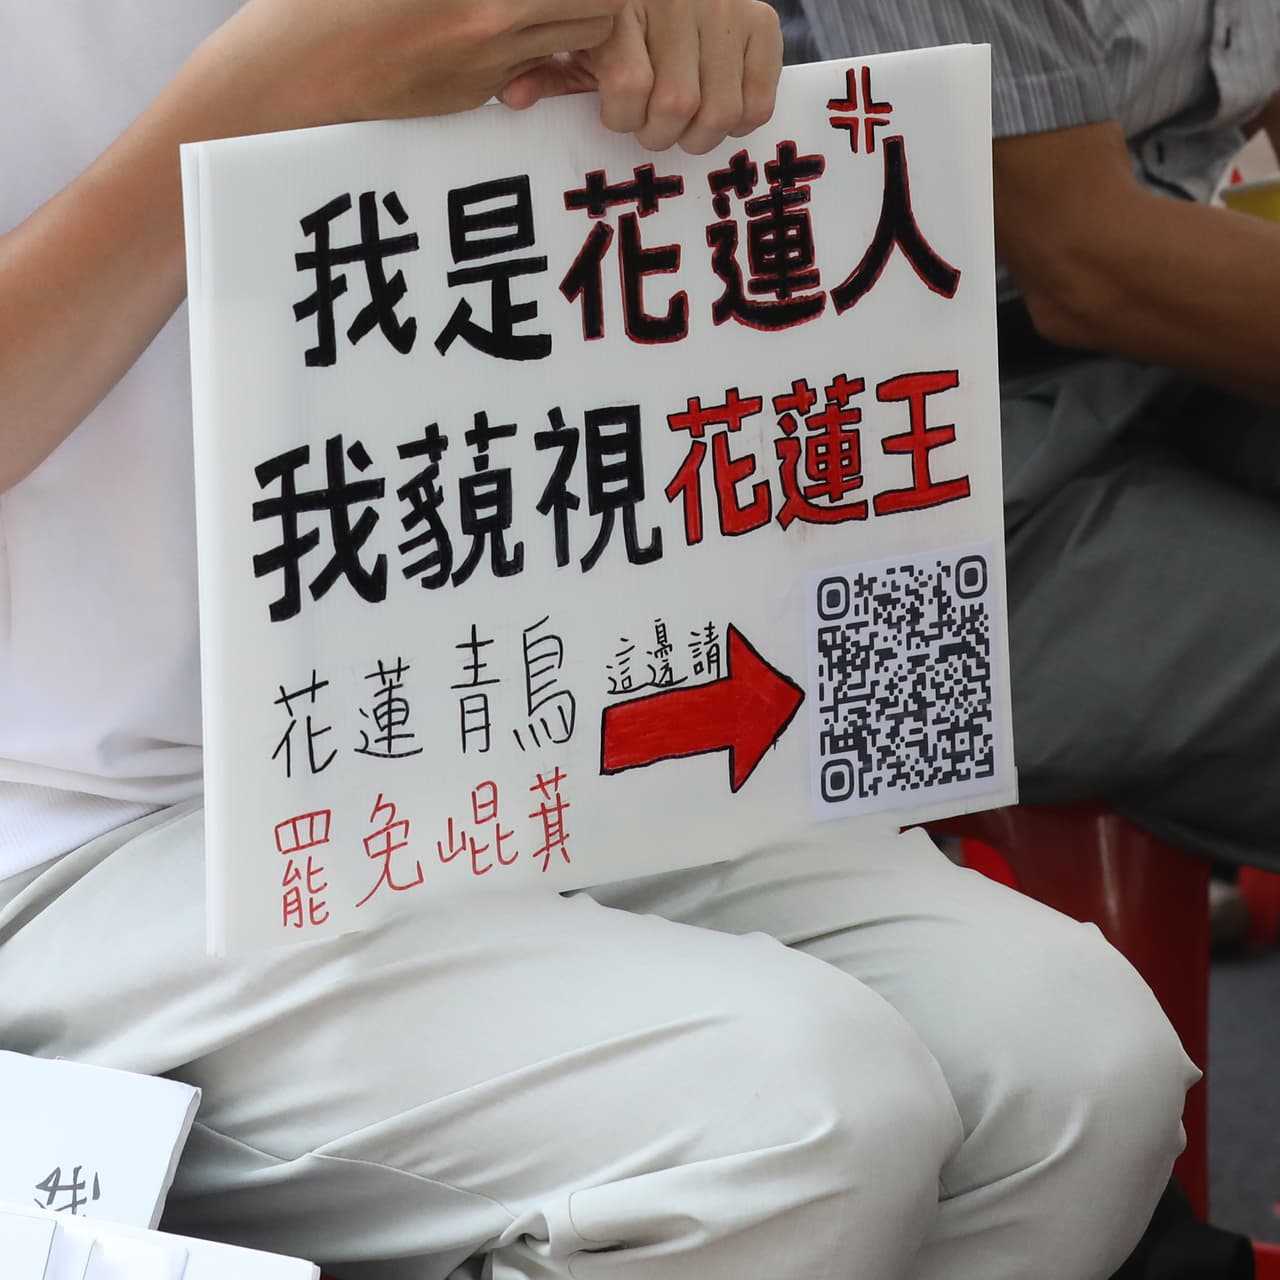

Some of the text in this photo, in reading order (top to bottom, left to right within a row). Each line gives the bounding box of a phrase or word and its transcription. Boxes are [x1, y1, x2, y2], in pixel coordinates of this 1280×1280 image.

[292, 135, 961, 368] 我是花蓮人
[251, 369, 972, 622] 我藐視花蓮王
[271, 615, 577, 778] 花蓮青鳥
[606, 618, 722, 695] 這邊請
